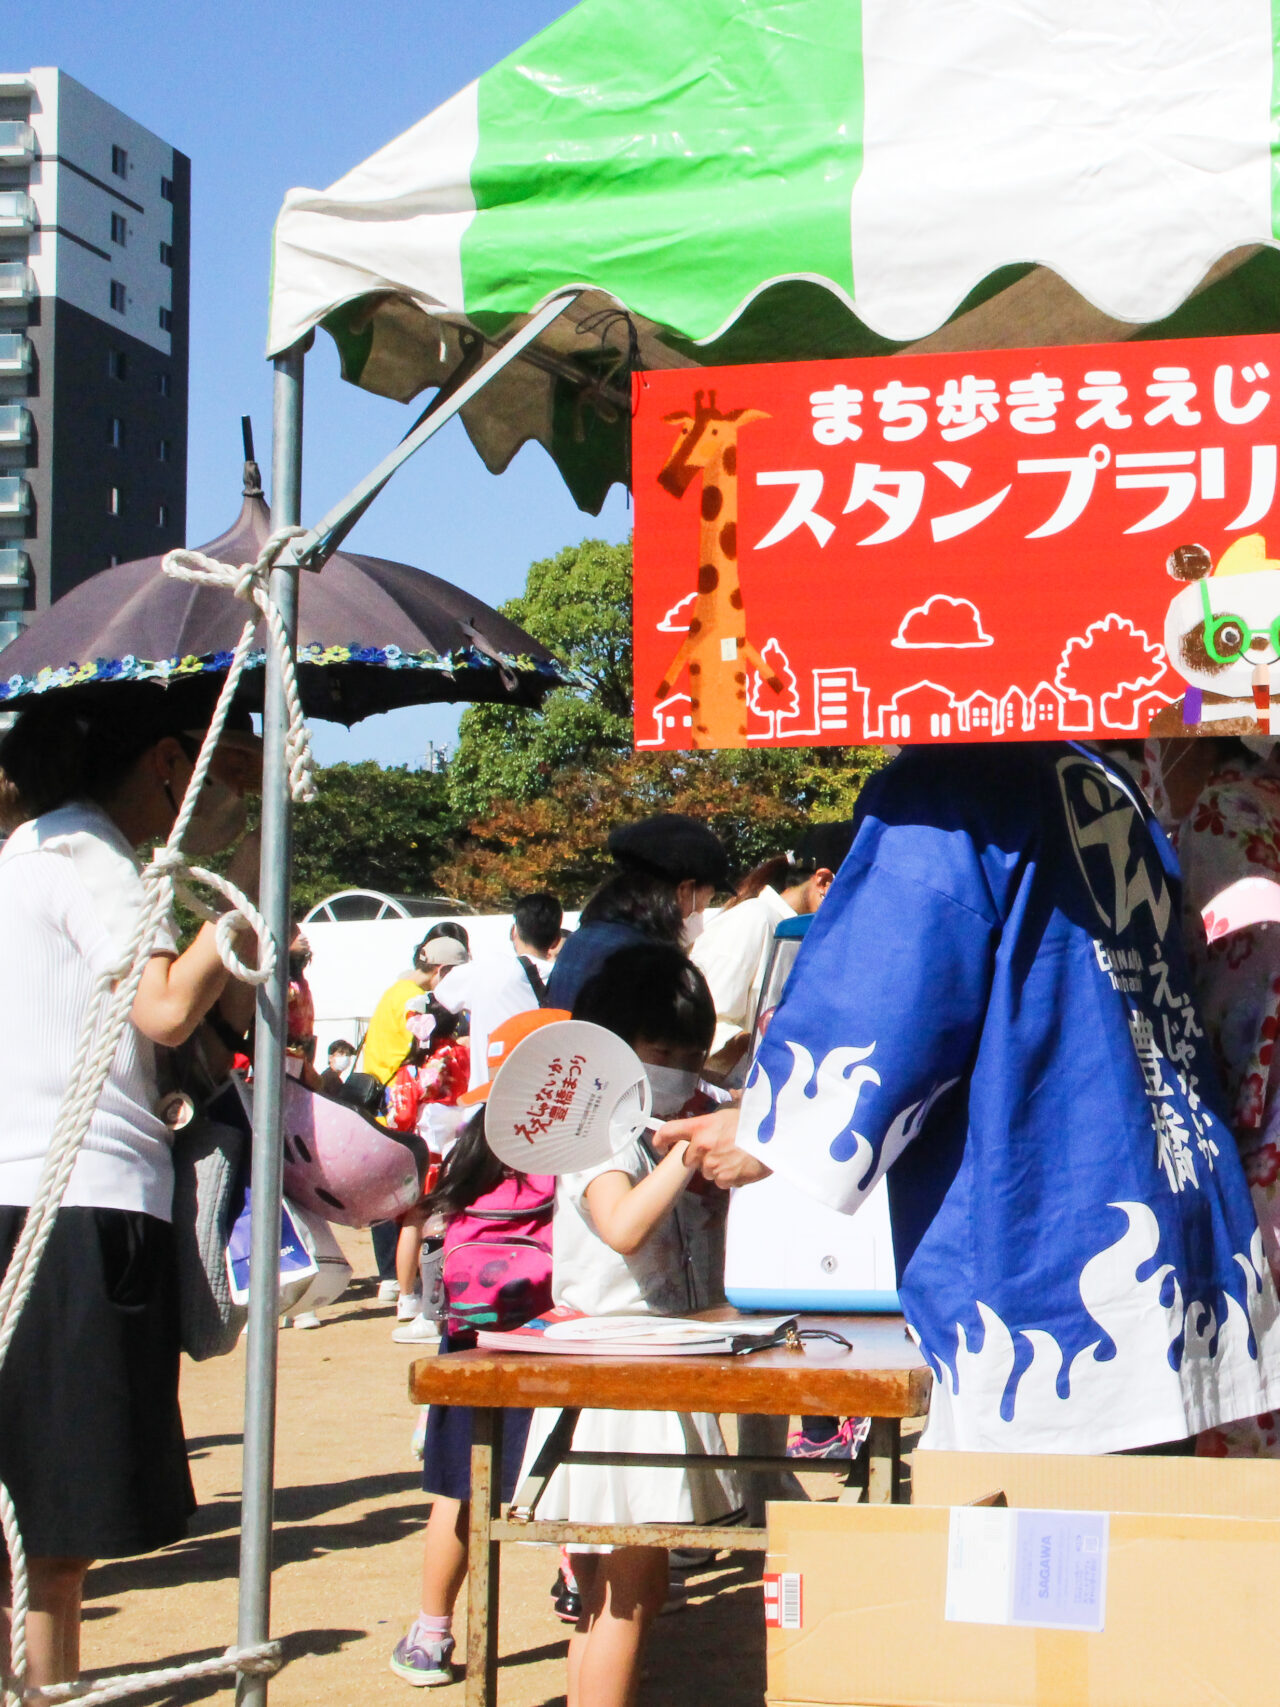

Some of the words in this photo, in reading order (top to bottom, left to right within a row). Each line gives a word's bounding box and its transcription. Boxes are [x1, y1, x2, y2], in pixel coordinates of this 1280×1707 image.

[513, 1057, 563, 1144] ええじゃないか
[549, 1054, 587, 1122] 豊橋まつり
[1128, 1009, 1200, 1194] 豊橋
[1038, 1535, 1053, 1600] SAGAWA
